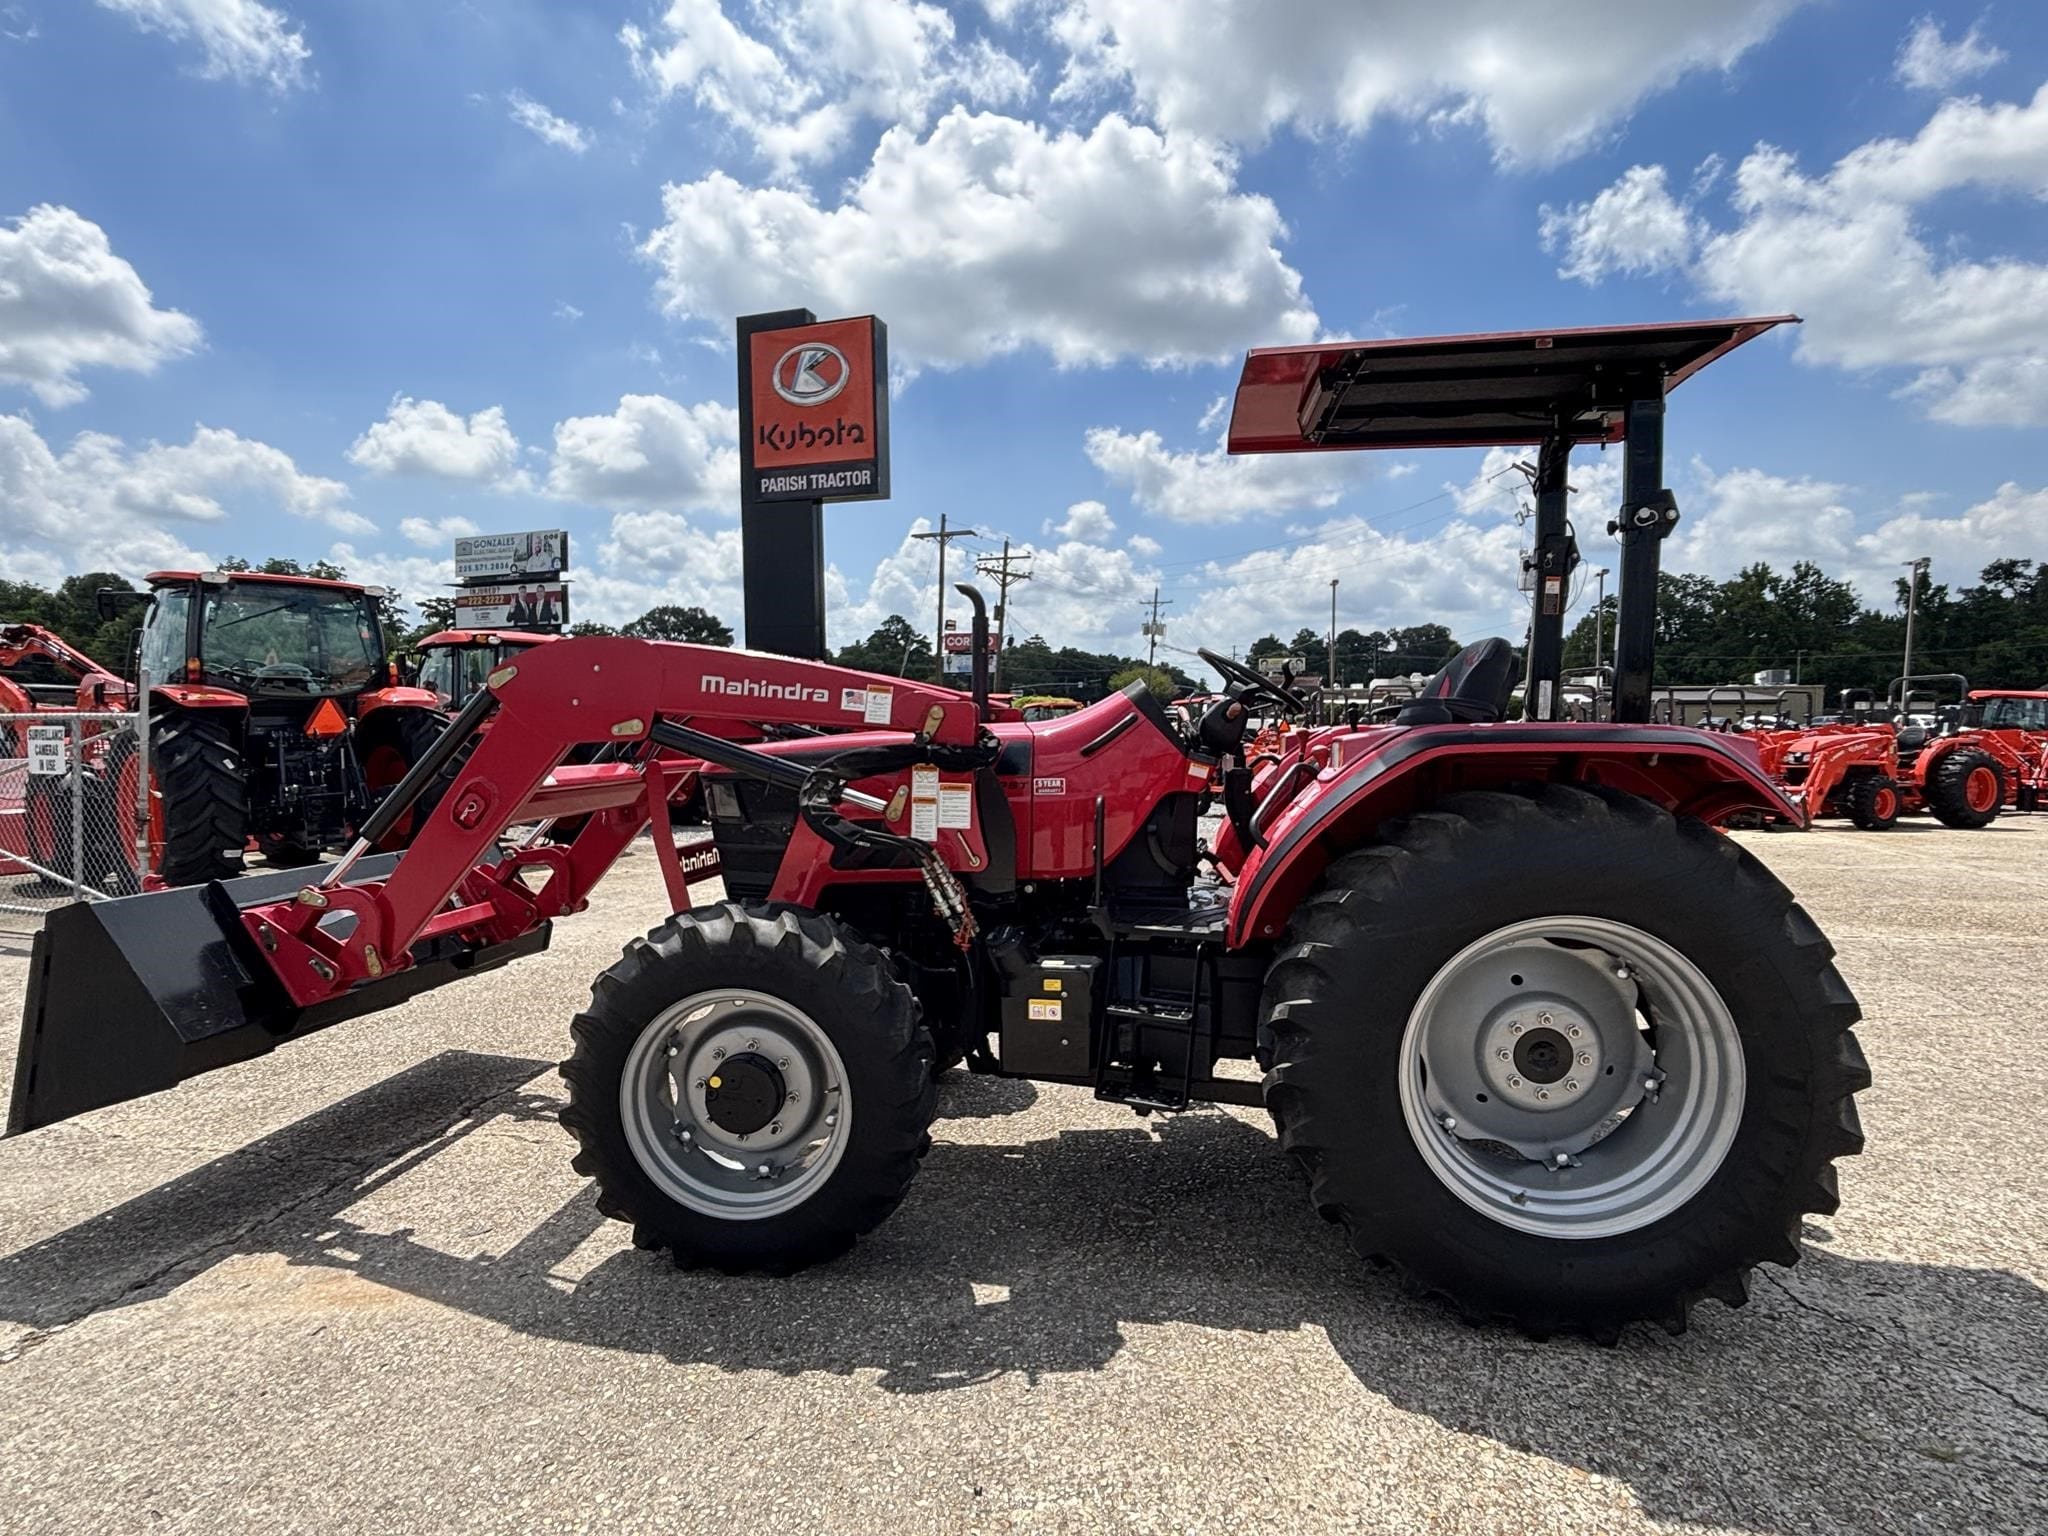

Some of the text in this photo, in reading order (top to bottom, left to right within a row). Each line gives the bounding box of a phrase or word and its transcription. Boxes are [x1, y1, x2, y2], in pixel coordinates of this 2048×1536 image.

[759, 418, 864, 451] Kubota
[761, 470, 871, 493] PARISH TRACTOR
[473, 538, 515, 548] GONZALES
[469, 587, 500, 595] INJURED?
[467, 595, 504, 605] 222-2222
[700, 674, 829, 703] Mahindra
[28, 729, 64, 741] SURVEILLANCE
[35, 744, 58, 756] CAMERAS
[39, 760, 56, 771] IN USE
